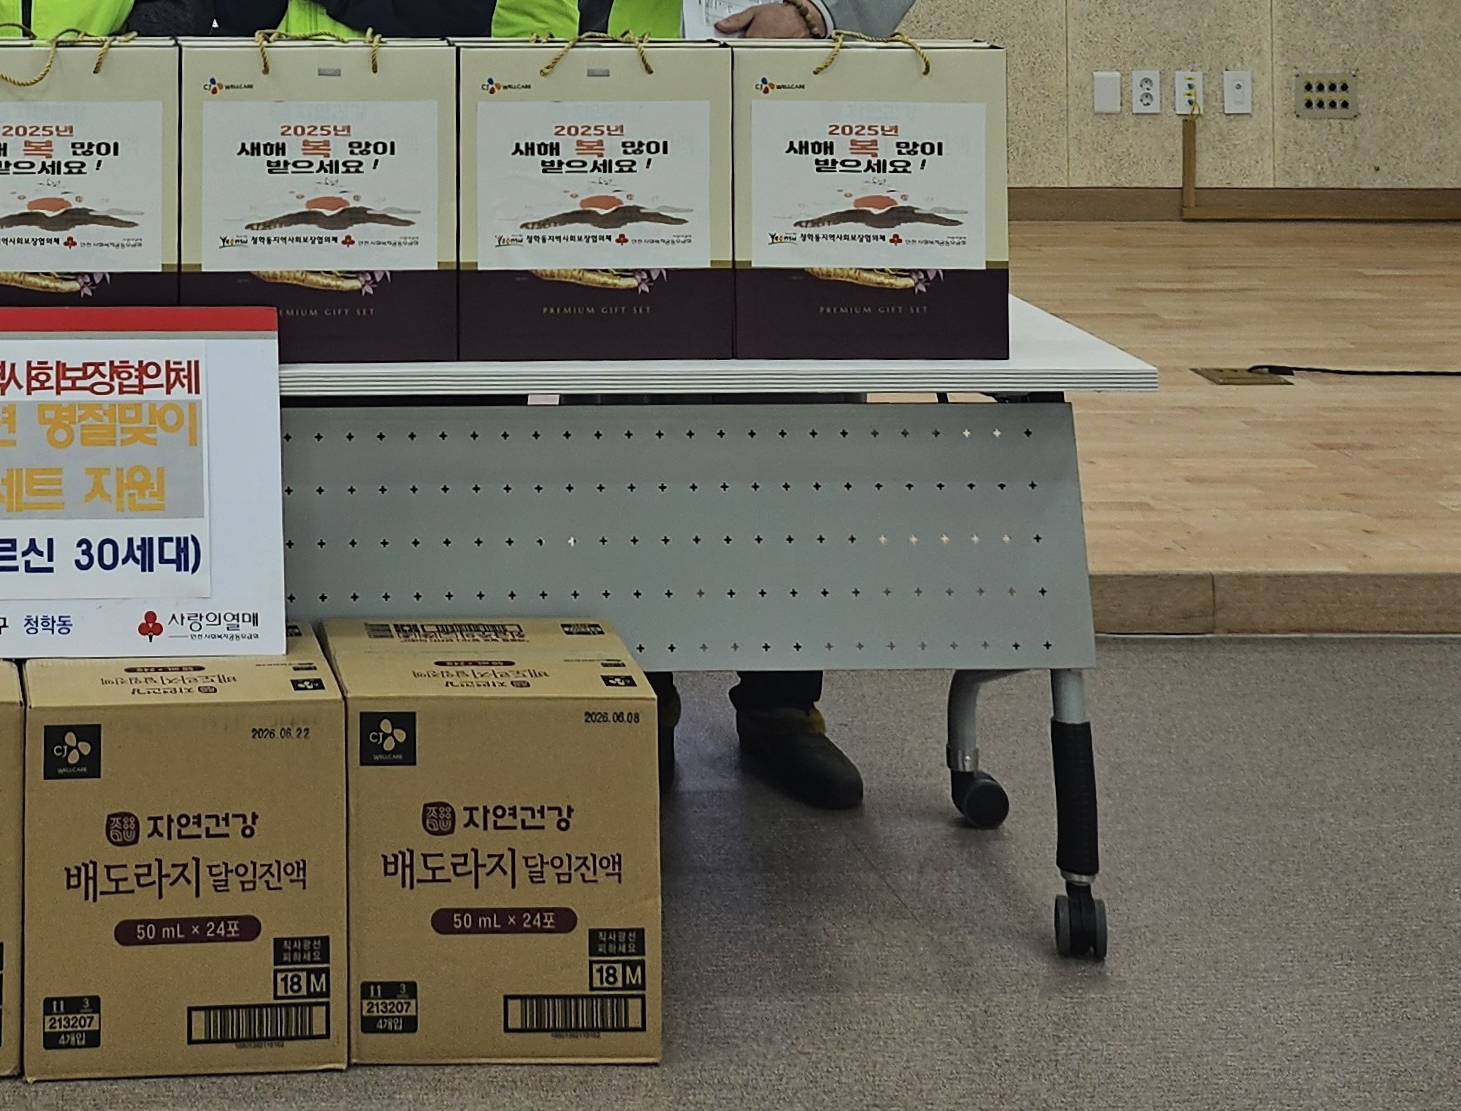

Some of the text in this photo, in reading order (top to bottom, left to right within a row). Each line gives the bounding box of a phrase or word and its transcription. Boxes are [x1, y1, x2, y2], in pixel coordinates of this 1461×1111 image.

[2, 125, 74, 137] 2025년
[280, 125, 351, 137] 2025년
[554, 124, 624, 137] 2025년
[828, 124, 898, 136] 2025년
[23, 140, 54, 158] 복
[71, 142, 119, 157] 많이
[237, 140, 395, 157] 새해 복 많이
[512, 140, 668, 157] 새해 복 많이
[785, 139, 943, 157] 새해 복 많이
[37, 403, 197, 450] 명절맞이
[84, 466, 166, 513] 지원
[74, 534, 201, 575] 30세대)
[23, 615, 73, 636] 청학동
[168, 611, 259, 632] 사랑의열매
[369, 732, 383, 743] CJ
[54, 745, 68, 755] CJ
[147, 812, 259, 840] 자연건강
[463, 805, 574, 831] 자연건강
[382, 848, 623, 890] 배도라지 달임진액
[64, 857, 307, 903] 배도라지 달임진액
[453, 913, 556, 928] 50 mL 24포
[137, 922, 240, 939] 50 mL 24포
[366, 1000, 411, 1014] 213207
[49, 1015, 94, 1029] 213207
